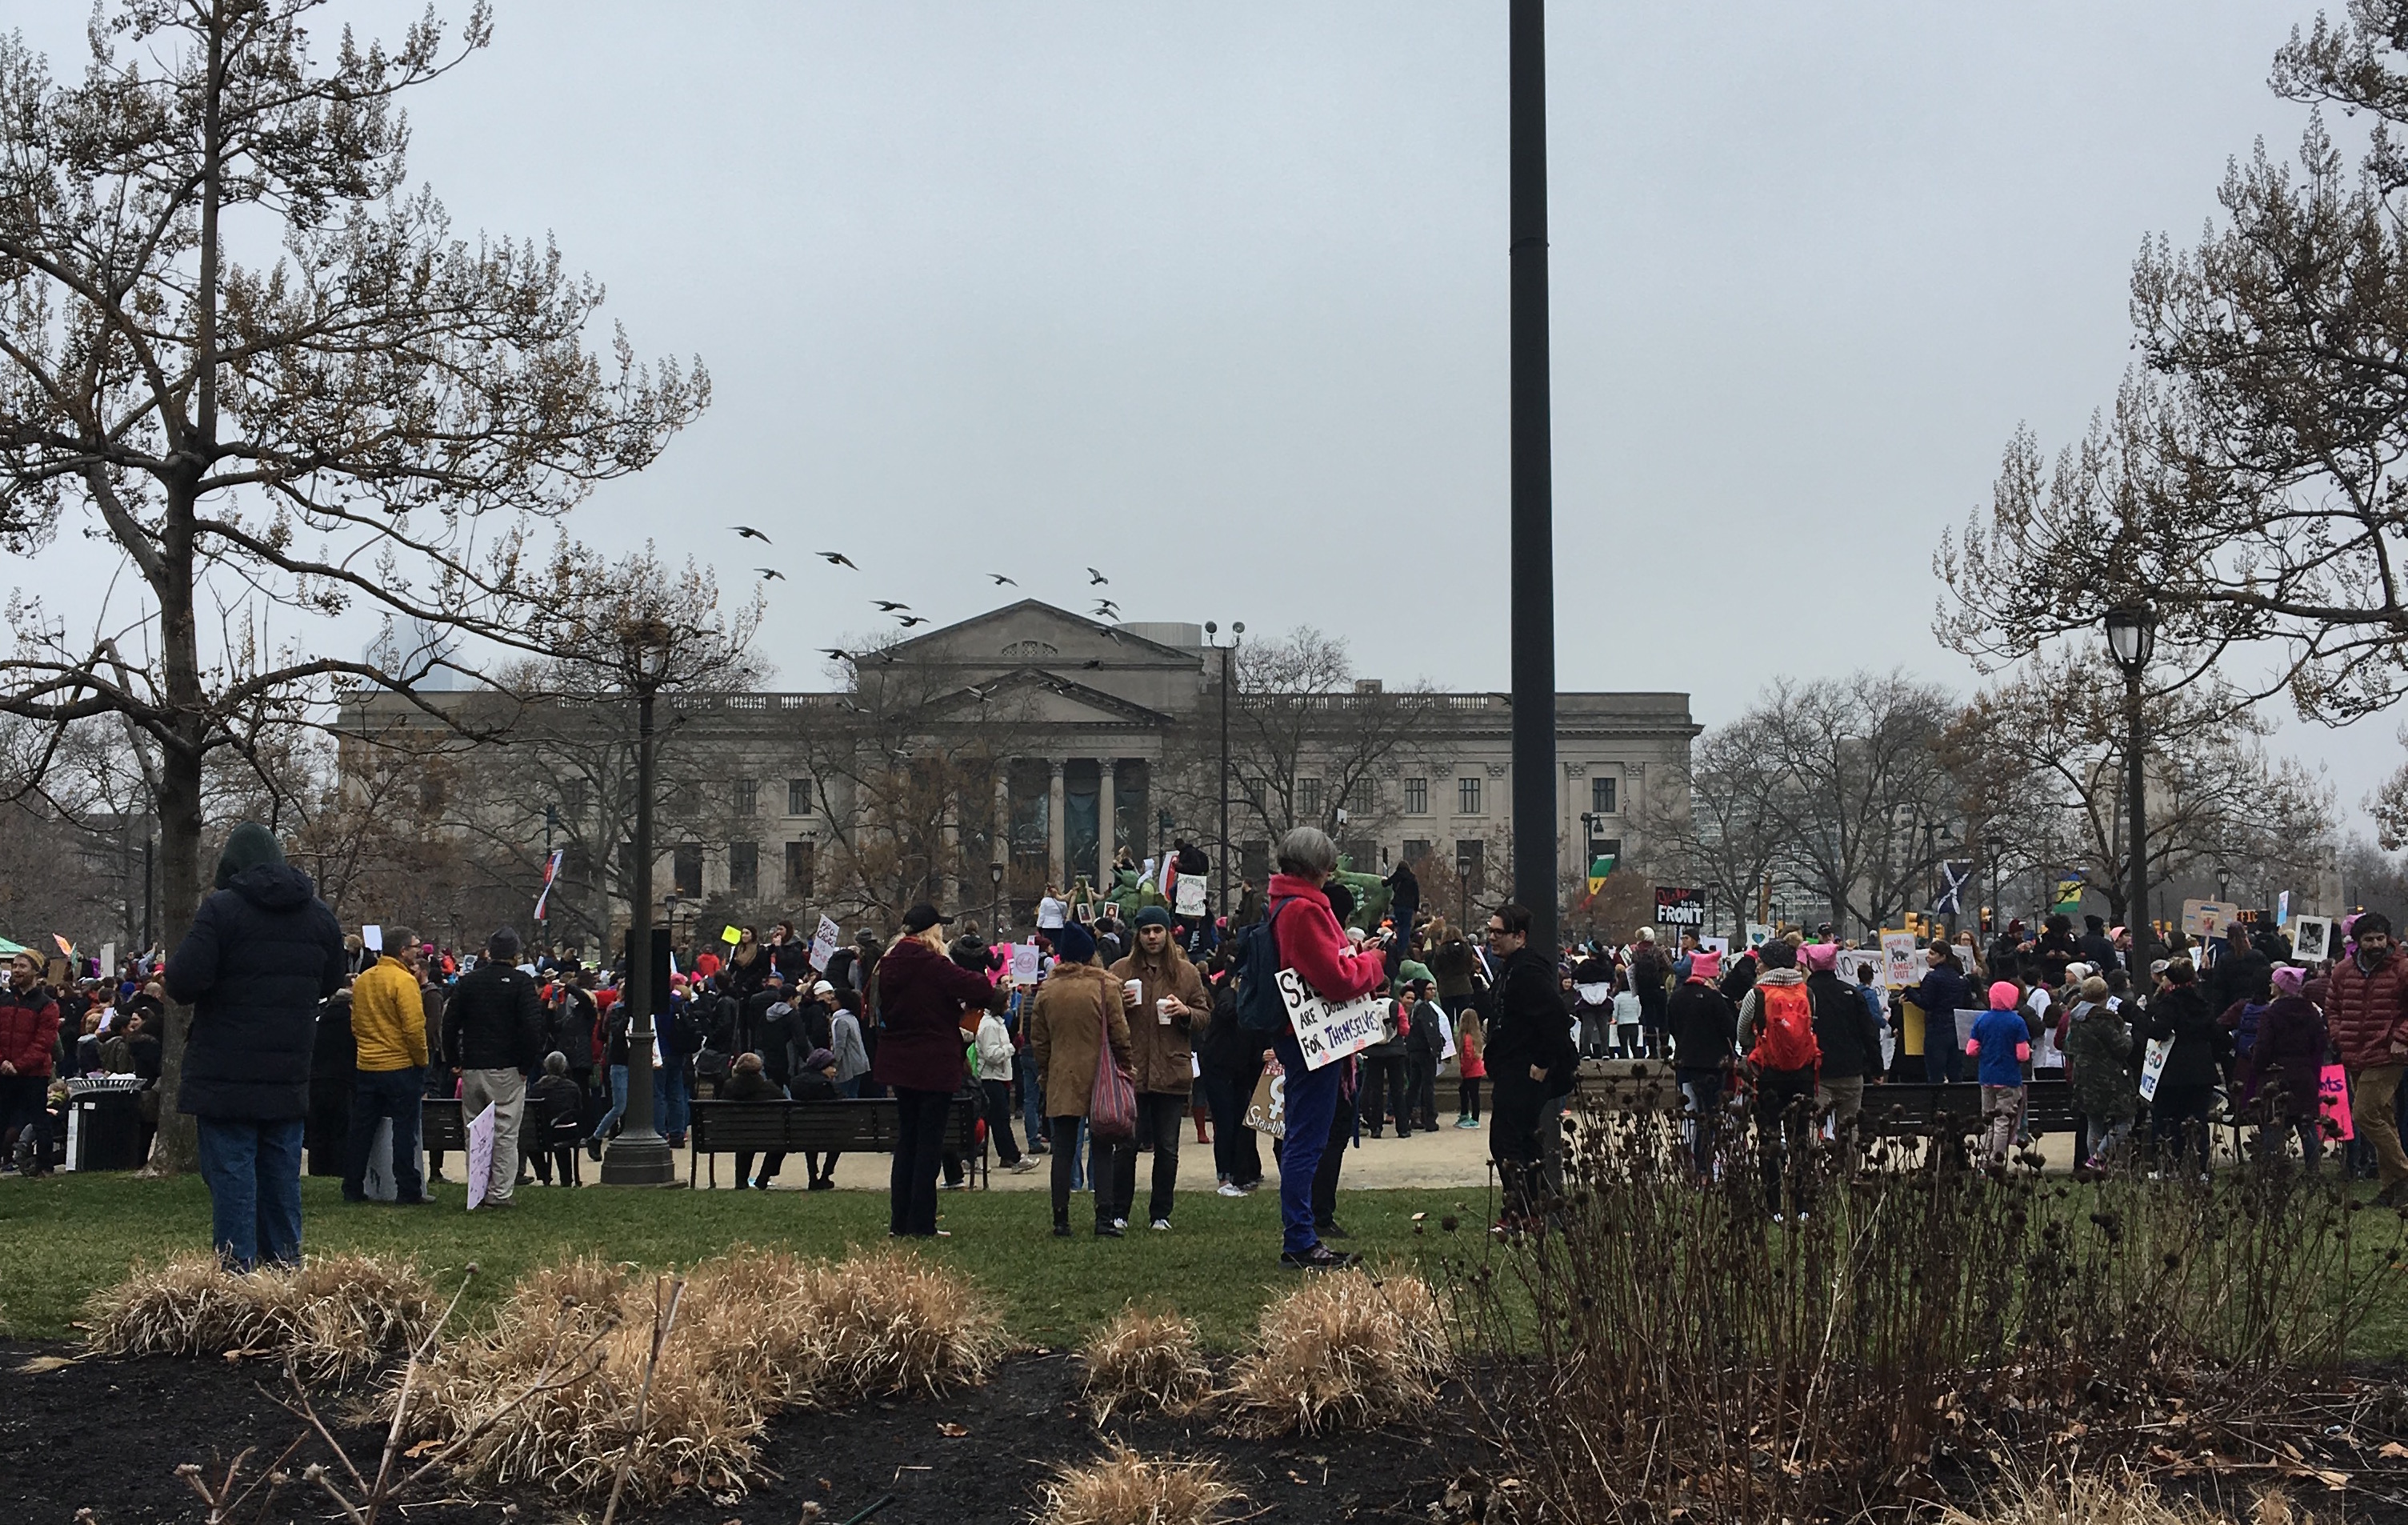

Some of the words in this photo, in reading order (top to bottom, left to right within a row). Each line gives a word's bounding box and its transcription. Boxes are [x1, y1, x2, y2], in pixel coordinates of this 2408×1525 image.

[1658, 904, 1704, 924] FRONT
[1835, 956, 1854, 978] NO
[1889, 962, 1914, 971] FANGS
[1894, 971, 1909, 979] OUT
[1299, 1007, 1318, 1030] ARE
[1301, 1033, 1325, 1058] FOR
[1324, 1010, 1380, 1049] THEMSELVES
